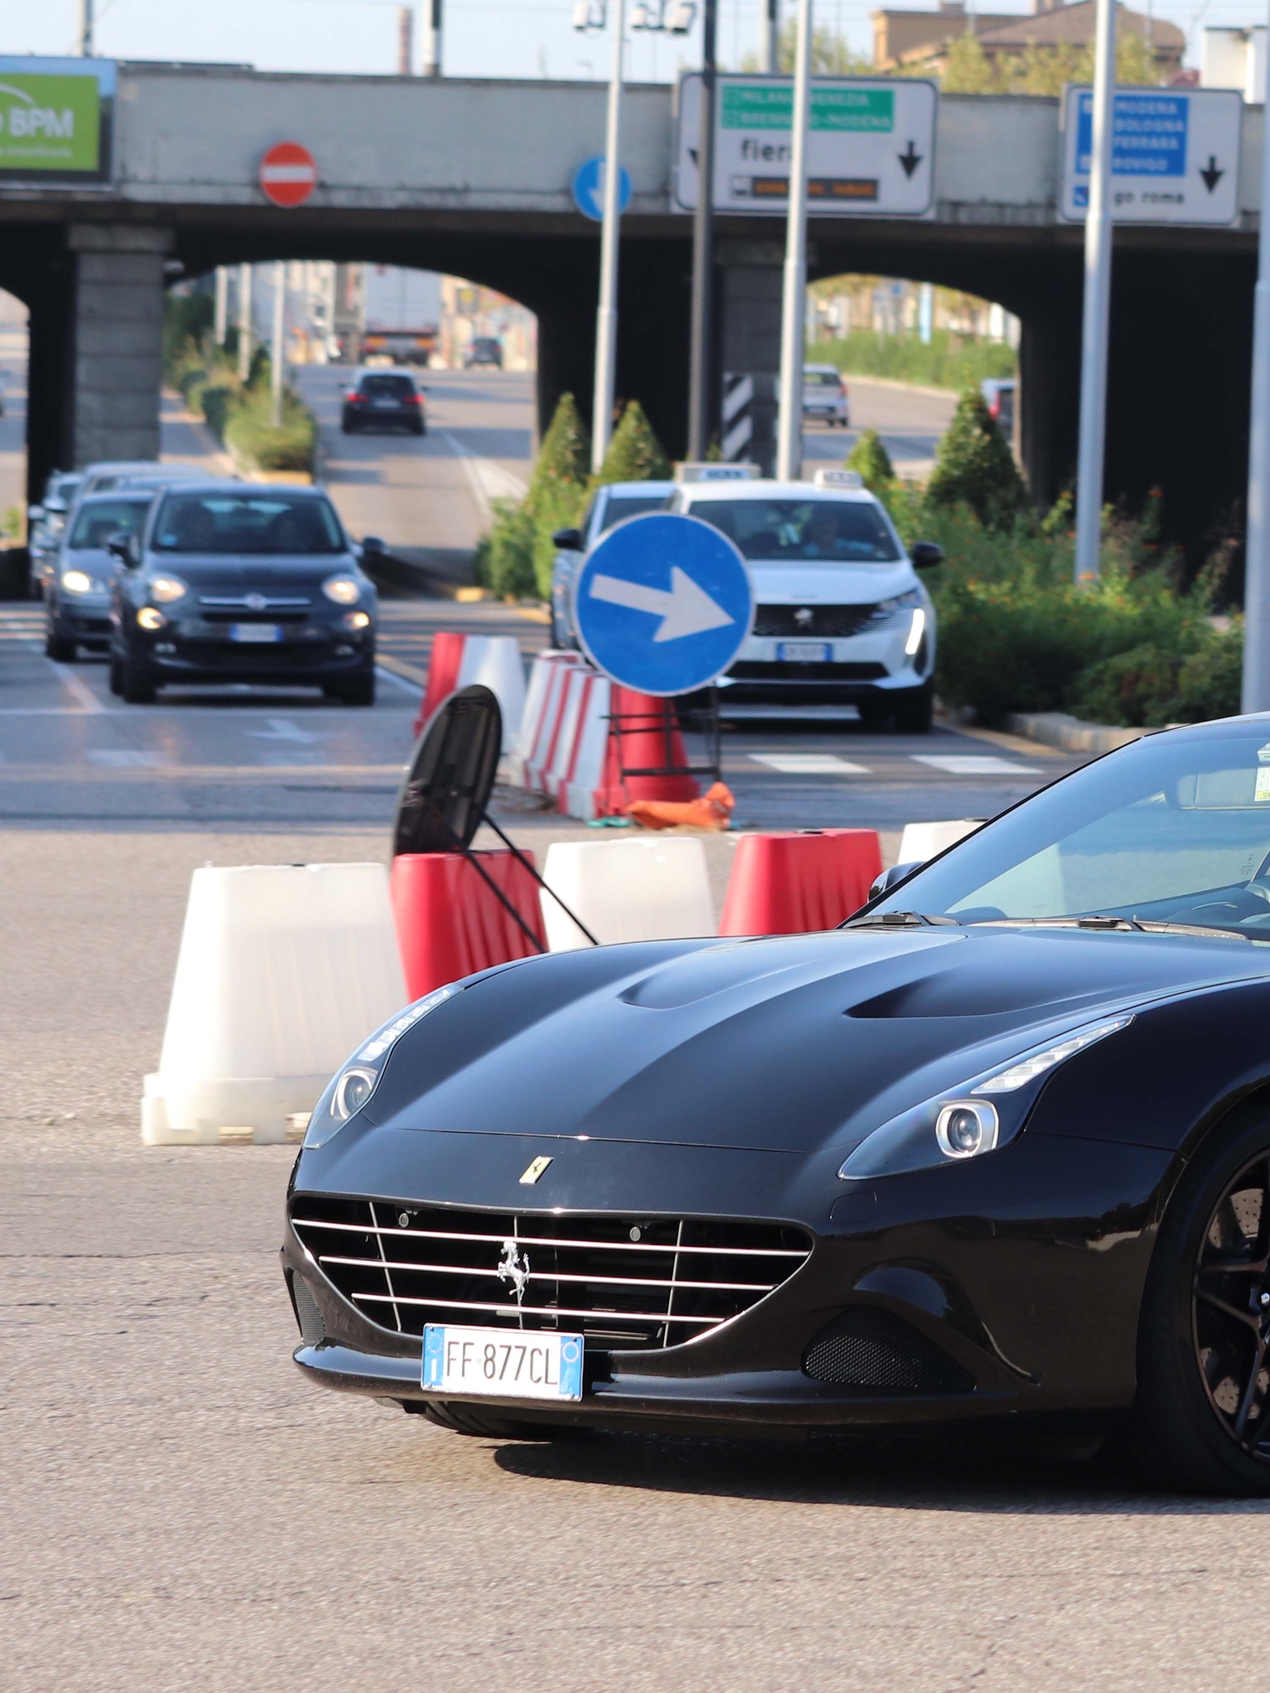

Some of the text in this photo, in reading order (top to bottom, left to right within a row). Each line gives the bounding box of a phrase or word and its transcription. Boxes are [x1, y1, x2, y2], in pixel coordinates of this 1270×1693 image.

[1116, 101, 1178, 114] MODENA
[10, 106, 74, 138] BPM
[1115, 118, 1184, 132] BOLOGNA
[1114, 135, 1178, 149] FERRARA
[1112, 157, 1168, 171] ROVIGO
[447, 1341, 557, 1385] FF 877CL
